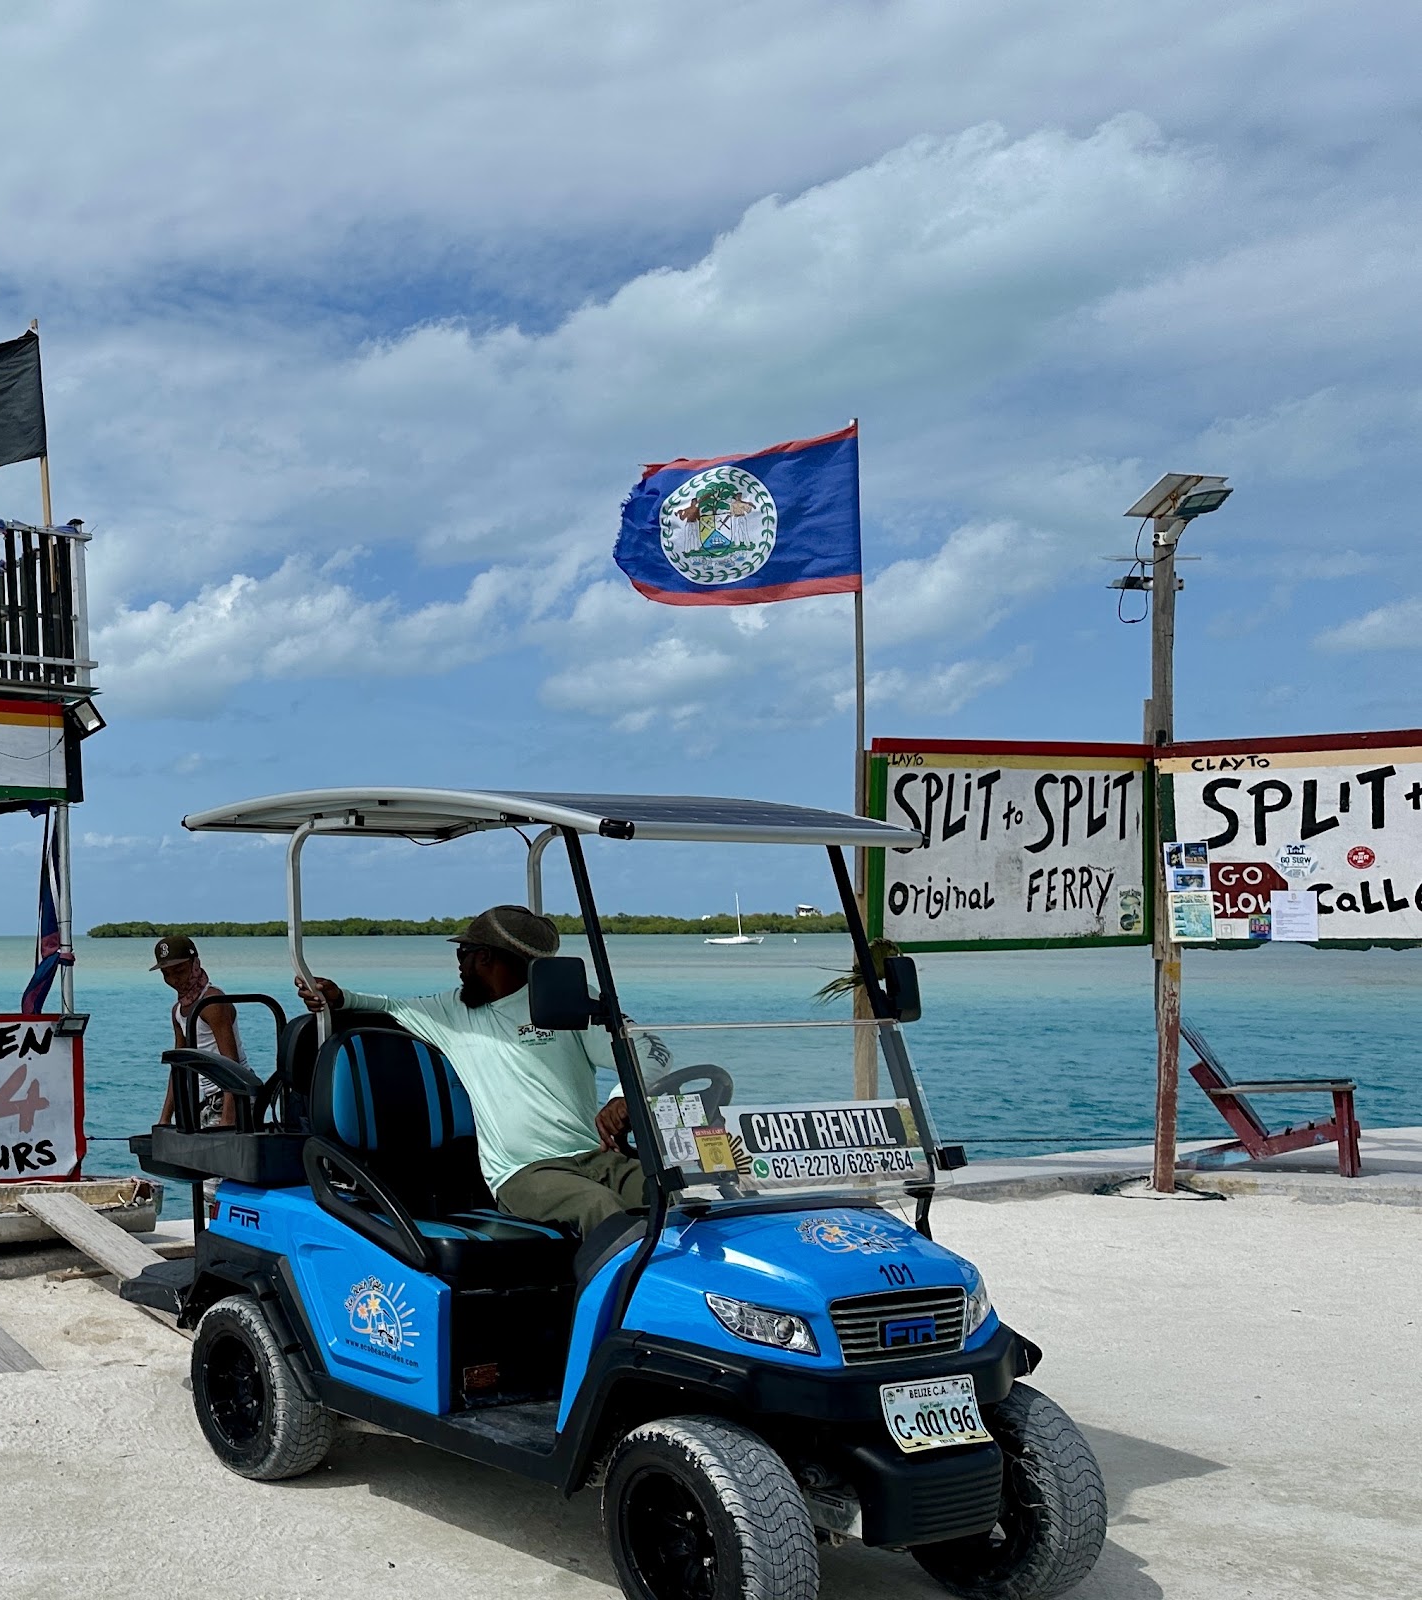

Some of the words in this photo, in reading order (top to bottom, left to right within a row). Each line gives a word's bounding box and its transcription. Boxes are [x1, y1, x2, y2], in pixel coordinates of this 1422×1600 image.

[886, 753, 924, 767] LAYTO
[1002, 800, 1023, 830] to
[1200, 765, 1397, 849] SPLIT
[1027, 866, 1115, 915] FERRY
[1218, 865, 1263, 886] GO
[750, 1112, 811, 1152] CART
[811, 1108, 898, 1149] RENTAL
[772, 1150, 914, 1179] 621-2278/628-7264
[879, 1262, 916, 1286] 101
[345, 1338, 419, 1368] www.ecobeachrides.com
[909, 1387, 931, 1399] BELIZE
[932, 1385, 949, 1396] C.A.
[894, 1405, 977, 1440] C-00196
